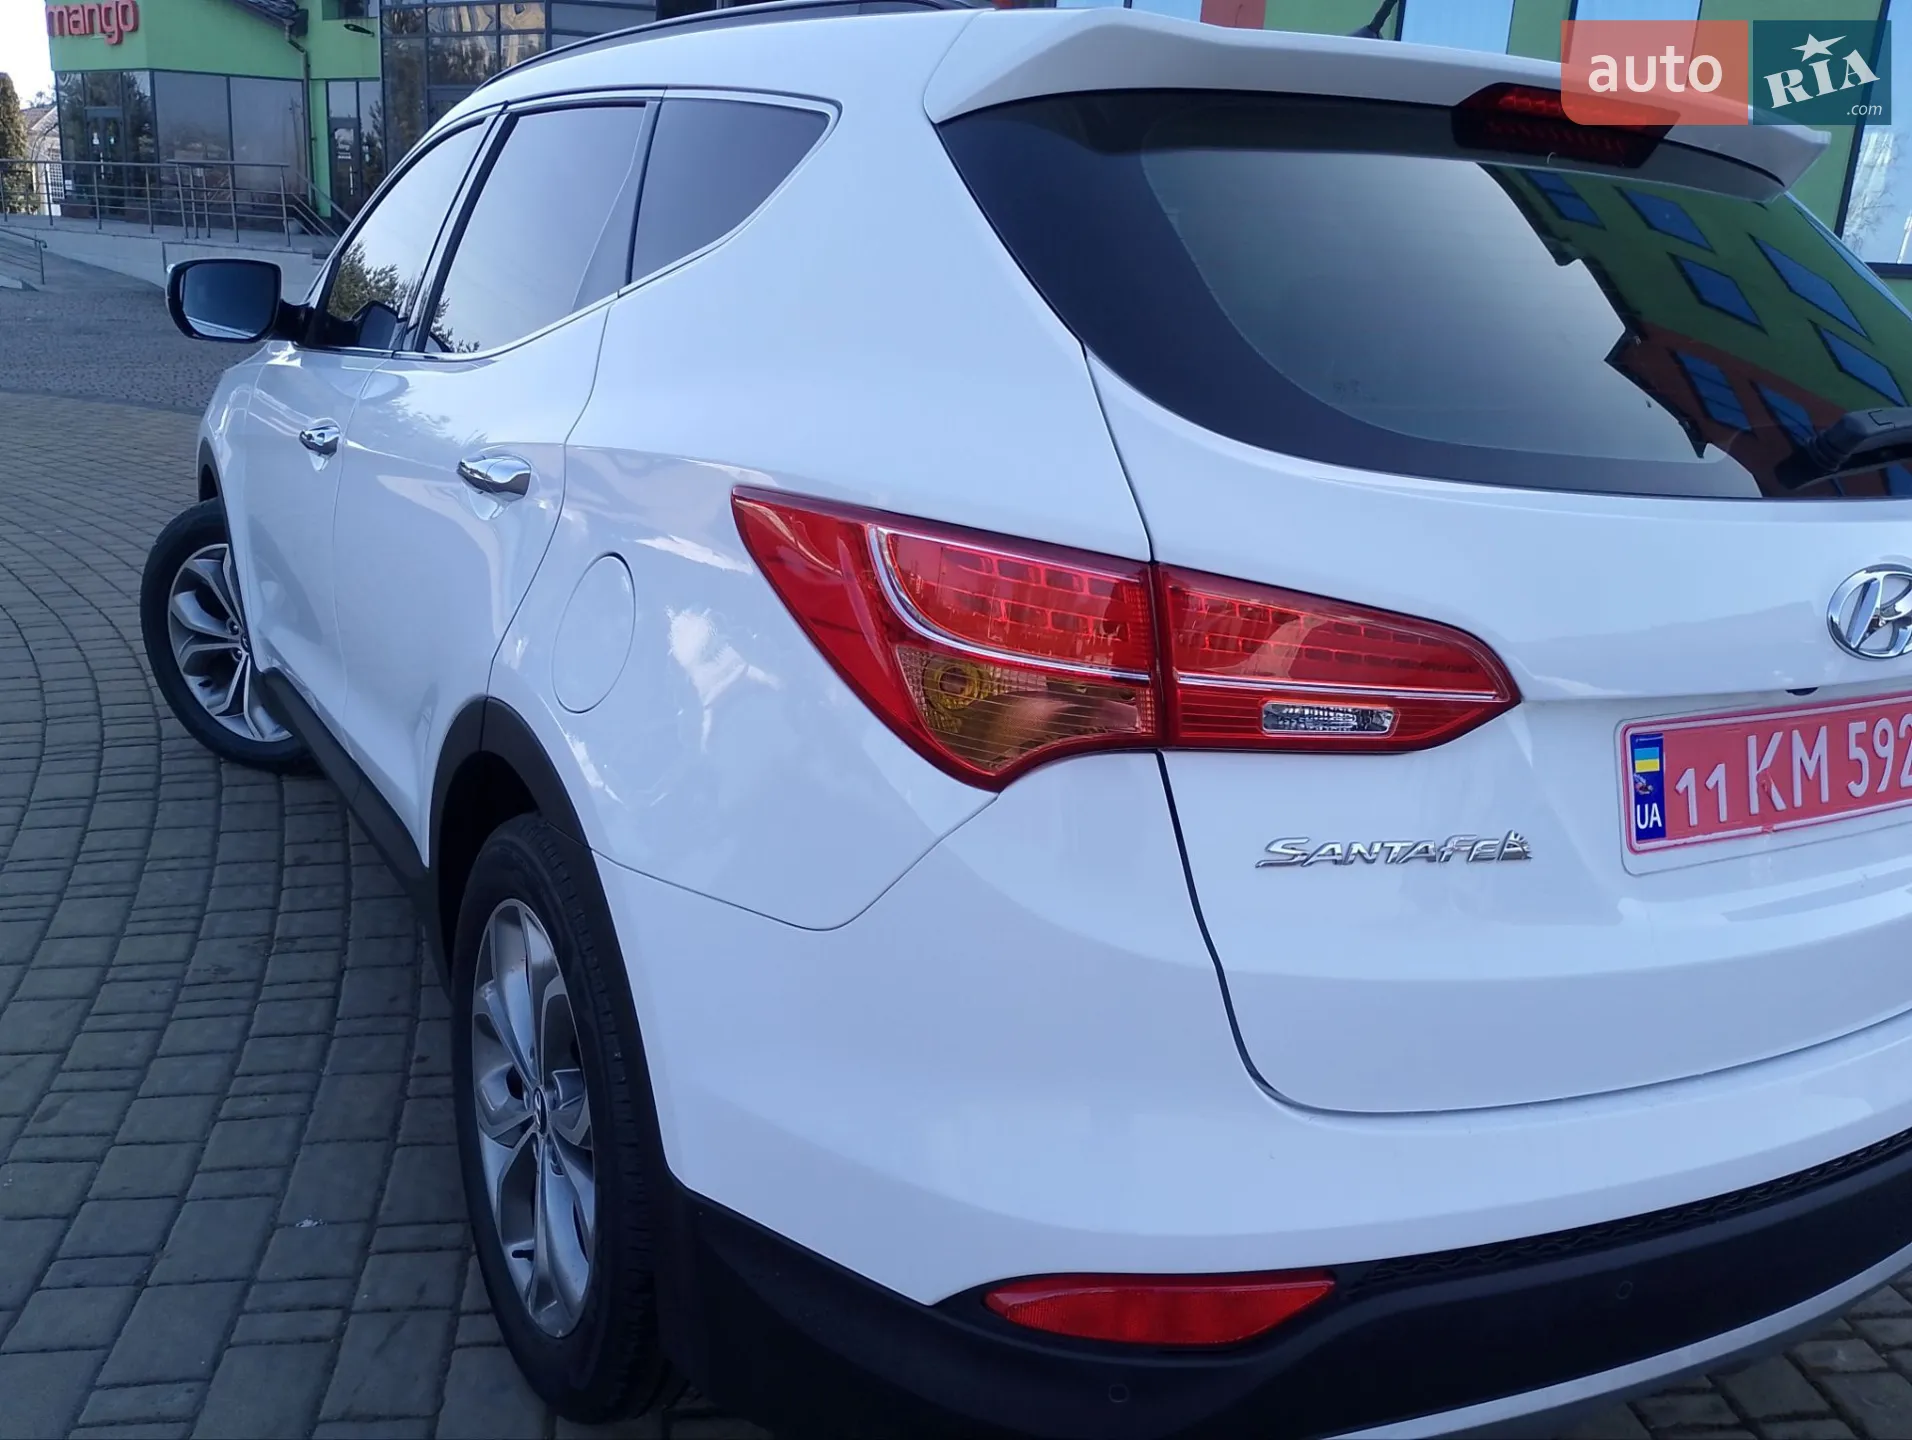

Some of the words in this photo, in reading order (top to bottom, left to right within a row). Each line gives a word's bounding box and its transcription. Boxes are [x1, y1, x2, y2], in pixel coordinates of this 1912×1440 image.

[45, 0, 139, 45] mango
[1675, 763, 1728, 827] 11
[1747, 725, 1830, 815] KM
[1636, 802, 1662, 830] UA
